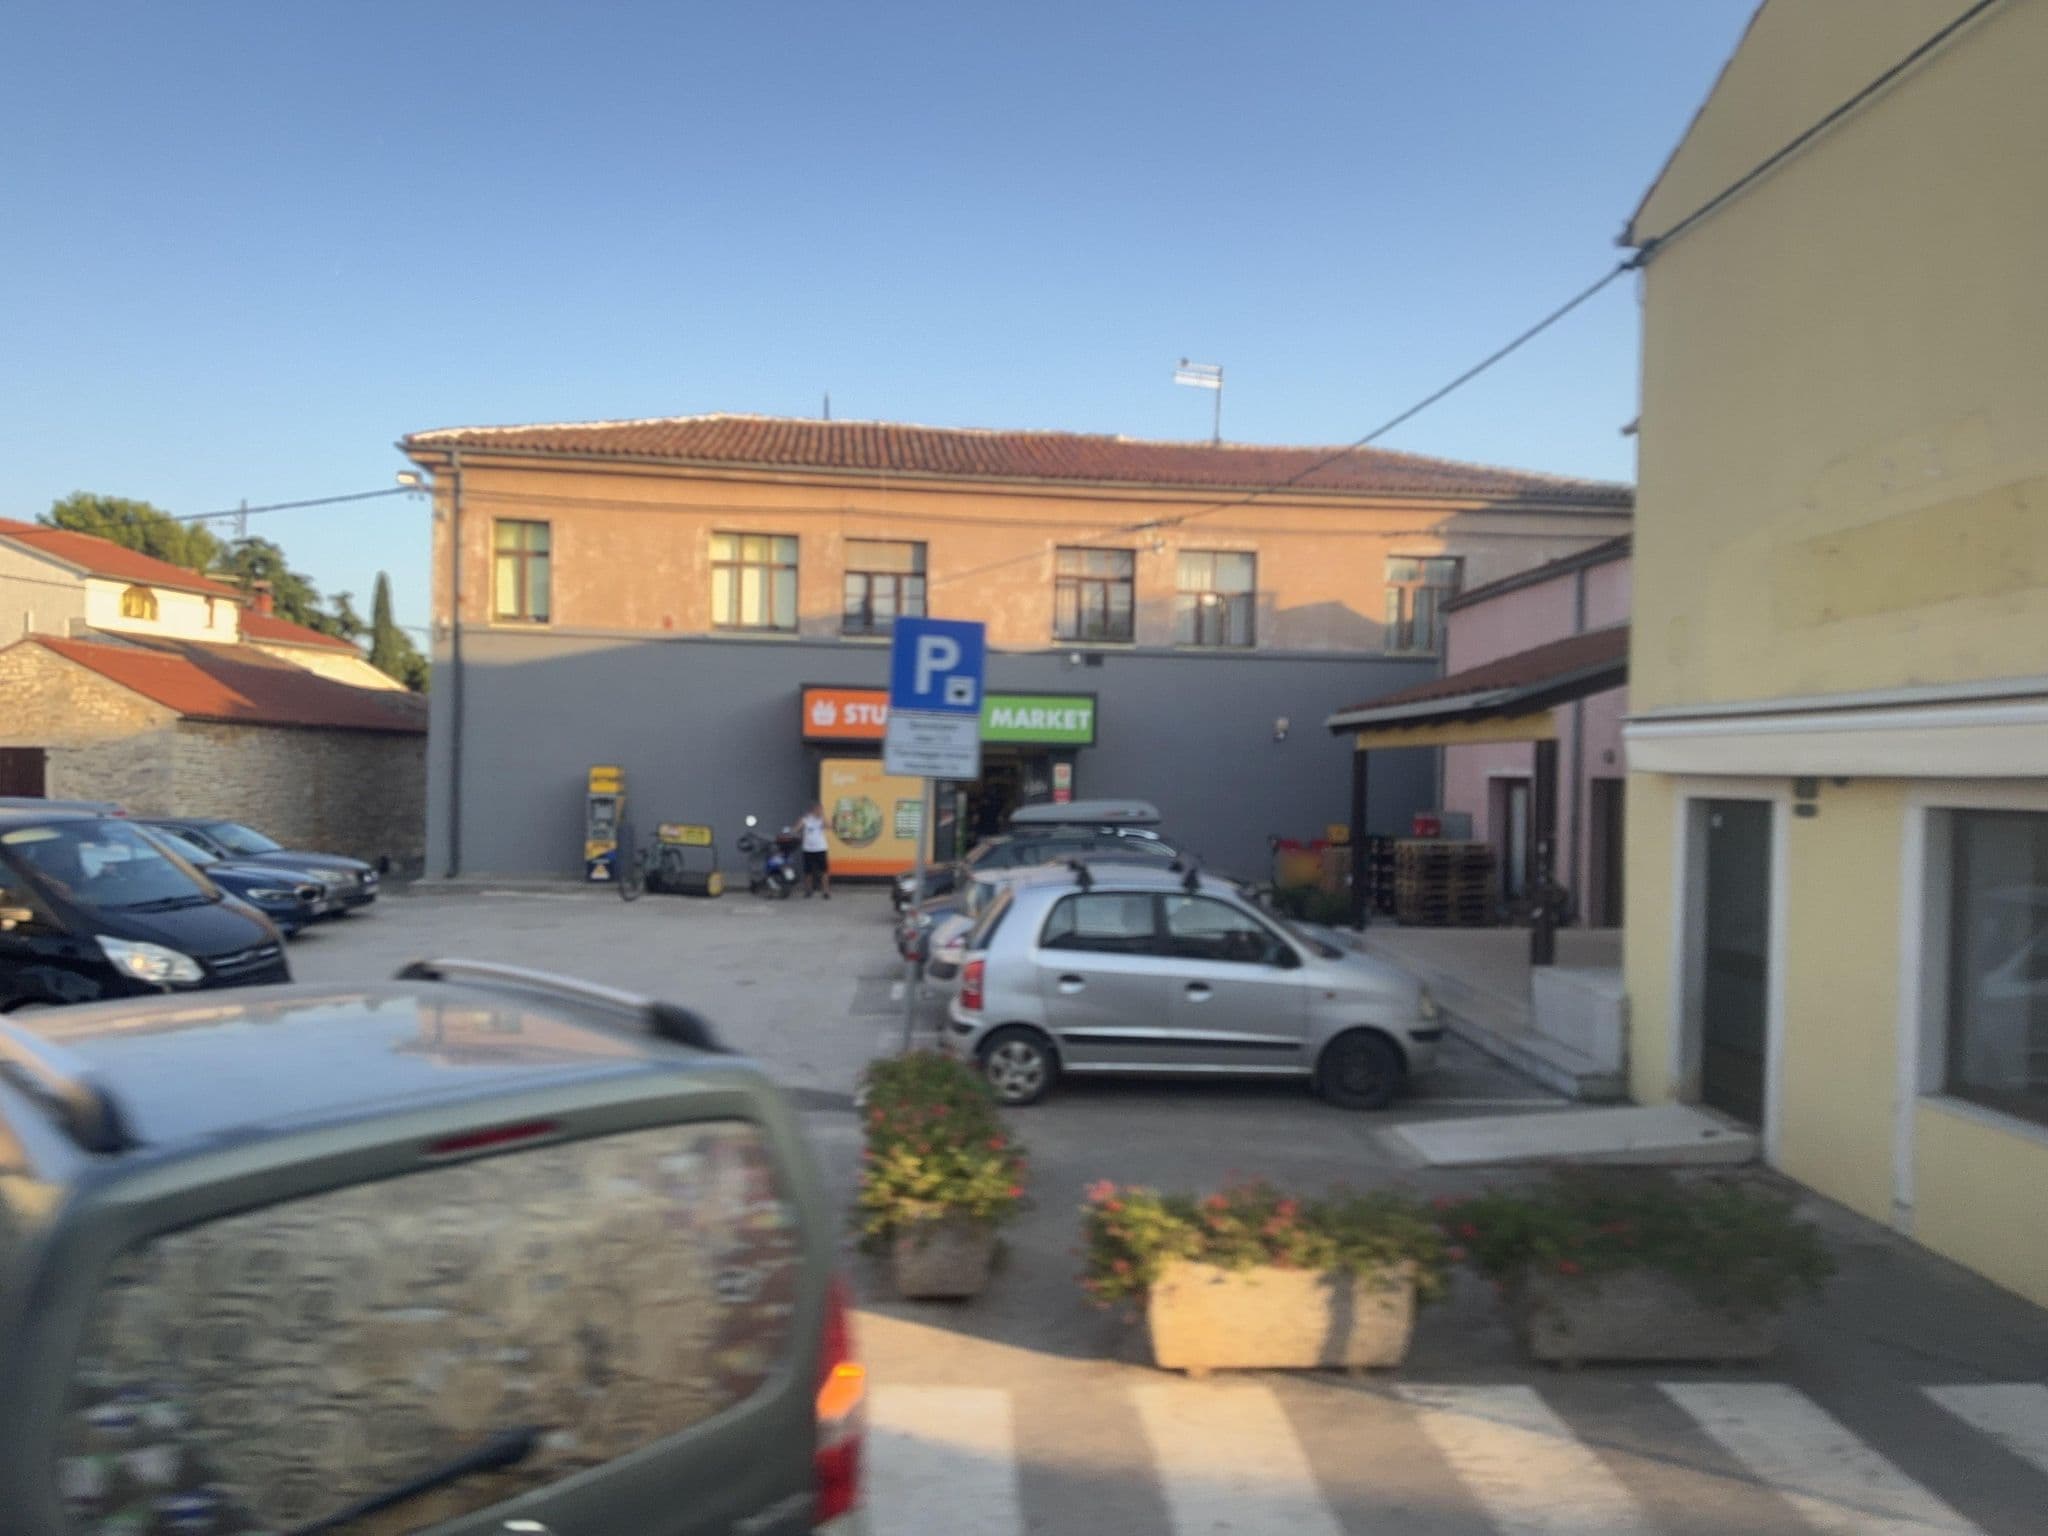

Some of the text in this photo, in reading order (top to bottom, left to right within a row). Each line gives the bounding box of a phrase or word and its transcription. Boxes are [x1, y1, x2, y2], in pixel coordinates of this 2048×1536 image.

[914, 634, 961, 695] P
[844, 703, 888, 726] STU
[990, 706, 1092, 731] MARKET
